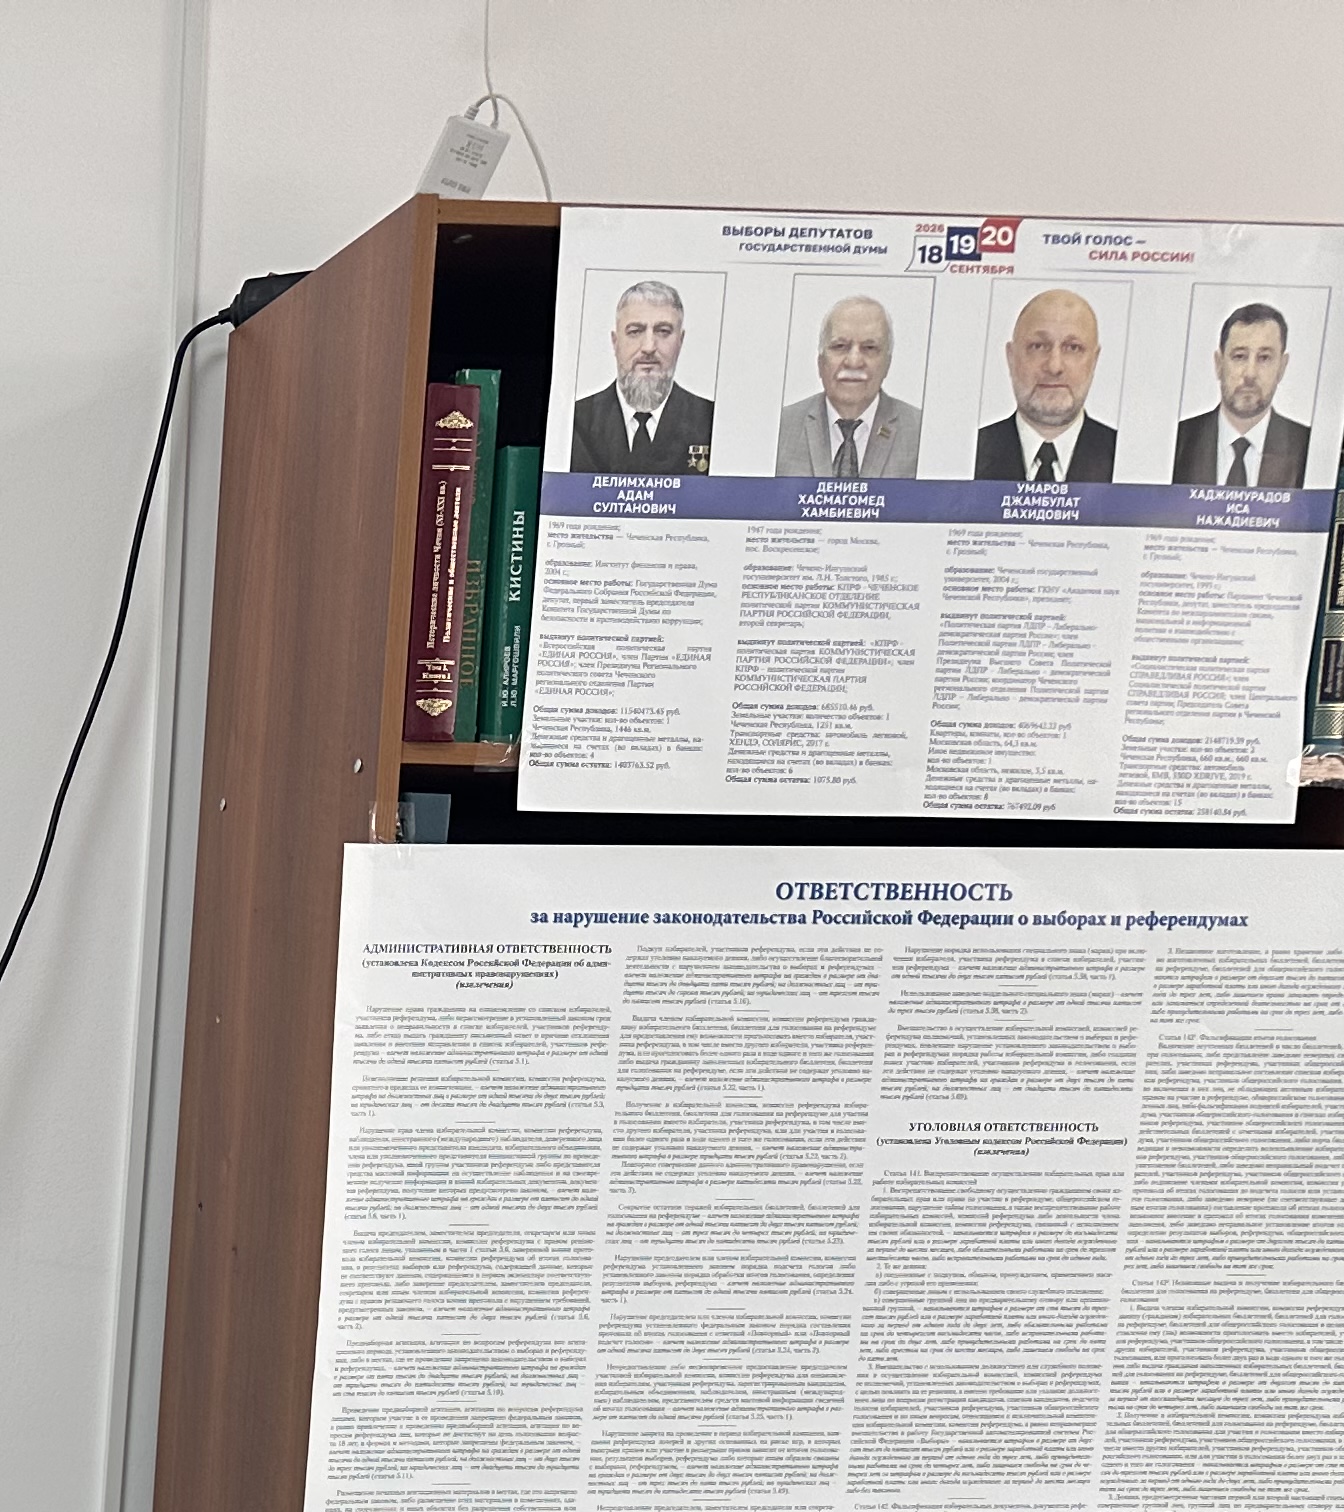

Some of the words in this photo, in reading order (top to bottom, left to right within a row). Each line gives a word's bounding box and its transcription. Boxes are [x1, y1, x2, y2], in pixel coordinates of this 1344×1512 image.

[722, 225, 785, 238] ВЫБОРЫ
[788, 227, 873, 240] ДЕПУТАТОВ
[915, 224, 945, 233] 2026
[918, 243, 943, 264] 18
[950, 233, 976, 255] 19
[982, 226, 1013, 247] 20
[1043, 232, 1081, 246] ТВОЙ
[1085, 234, 1131, 247] ГОЛОС
[738, 242, 851, 254] ГОСУДАРСТВЕННОЙ
[853, 245, 887, 256] ДУМЫ
[1089, 250, 1127, 262] СИЛА
[1131, 251, 1195, 263] РОССИИ!
[949, 263, 1014, 275] СЕНТЯБРЯ
[592, 476, 681, 490] ДЕЛИМХАНОВ
[816, 481, 868, 495] ДЕНИЕВ
[1016, 483, 1069, 495] УМАРОВ
[616, 489, 654, 502] АДАМ
[798, 494, 886, 508] ХАСМАГОМЕД
[1001, 495, 1080, 508] ДЖАМБУЛАТ
[1189, 488, 1291, 503] ХАДЖИМУРАДОВ
[593, 501, 676, 515] СУЛТАНОВИЧ
[801, 507, 880, 519] ХАМБИЕВИЧ
[1002, 508, 1079, 521] ВАХИДОВИЧ
[1226, 503, 1250, 515] ИСА
[1195, 515, 1281, 528] НАЖАДИЕВИЧ
[508, 510, 526, 602] КИСТИНЫ
[460, 560, 482, 688] ИЗБРАННОЕ
[775, 881, 1013, 902] ОТВЕТСТВЕННОСТЬ
[530, 911, 549, 924] за
[552, 910, 650, 928] нарушение
[652, 910, 807, 927] законодательства
[811, 907, 913, 926] Российской
[917, 909, 1014, 930] Федерации
[1018, 914, 1029, 926] о
[1032, 909, 1107, 930] выборах
[1110, 914, 1122, 926] и
[1125, 911, 1249, 931] референдумах
[362, 944, 493, 955] АДМИНИСТРАТИВНАЯ
[496, 944, 612, 954] ОТВЕТСТВЕННОСТЬ
[908, 1122, 982, 1132] УГОЛОВНАЯ
[984, 1122, 1099, 1132] ОТВЕТСТВЕННОСТЬ
